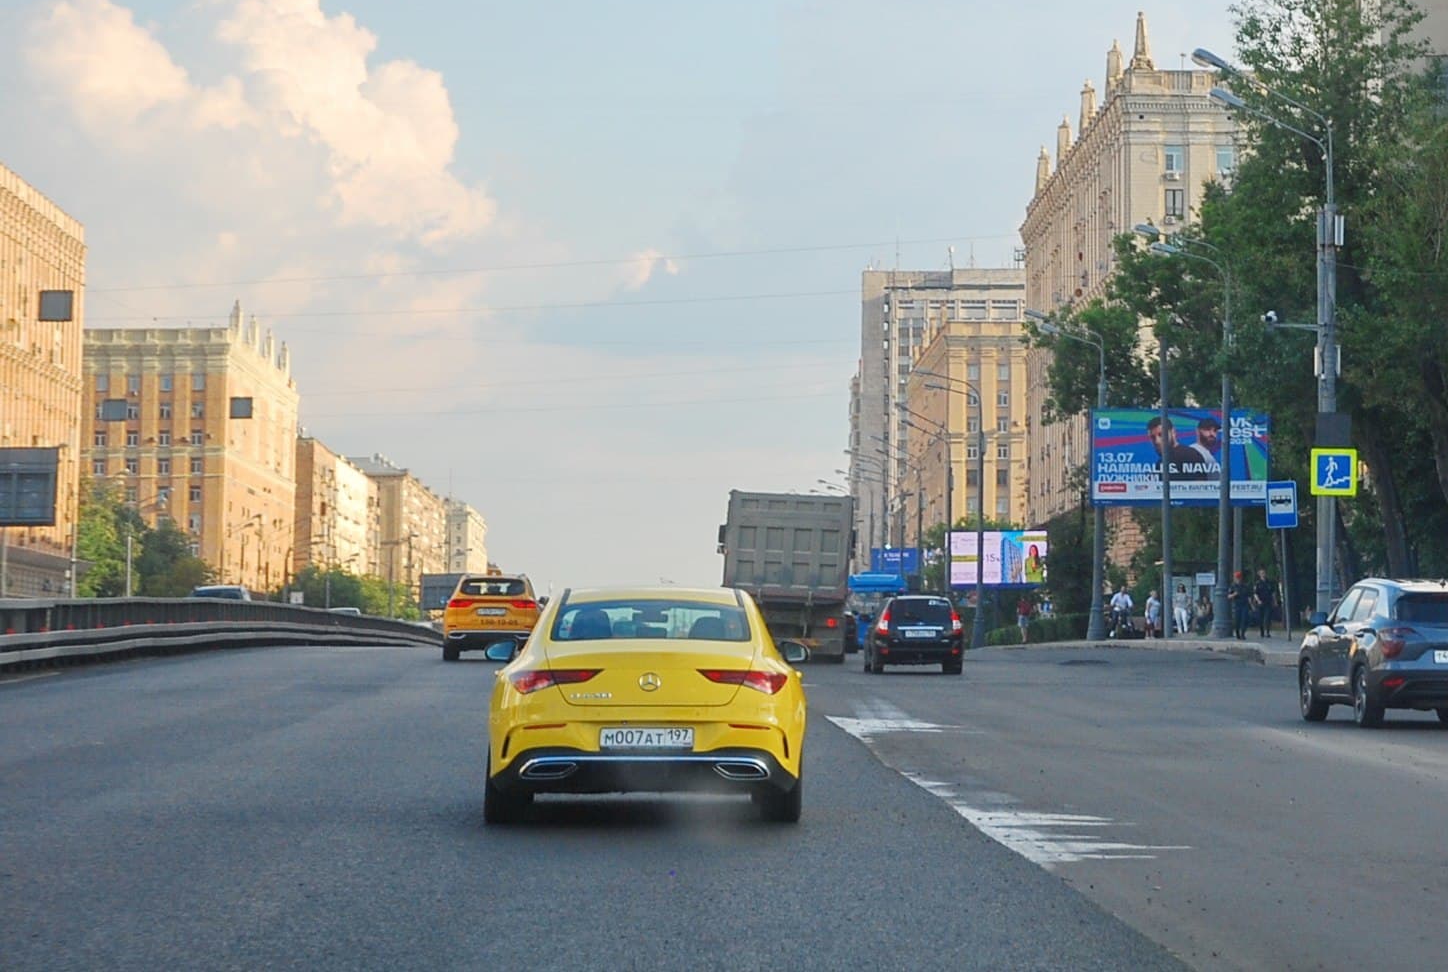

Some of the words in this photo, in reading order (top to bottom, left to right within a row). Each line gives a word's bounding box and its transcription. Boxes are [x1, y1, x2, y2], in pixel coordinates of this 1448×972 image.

[1230, 417, 1252, 428] VK
[1229, 424, 1267, 438] est
[1098, 452, 1135, 463] 13.07
[1168, 462, 1180, 474] &
[1182, 462, 1222, 474] NAVA
[1098, 473, 1160, 483] ЛУЖНИКИ
[604, 730, 664, 745] М007АТ
[668, 729, 690, 741] 197
